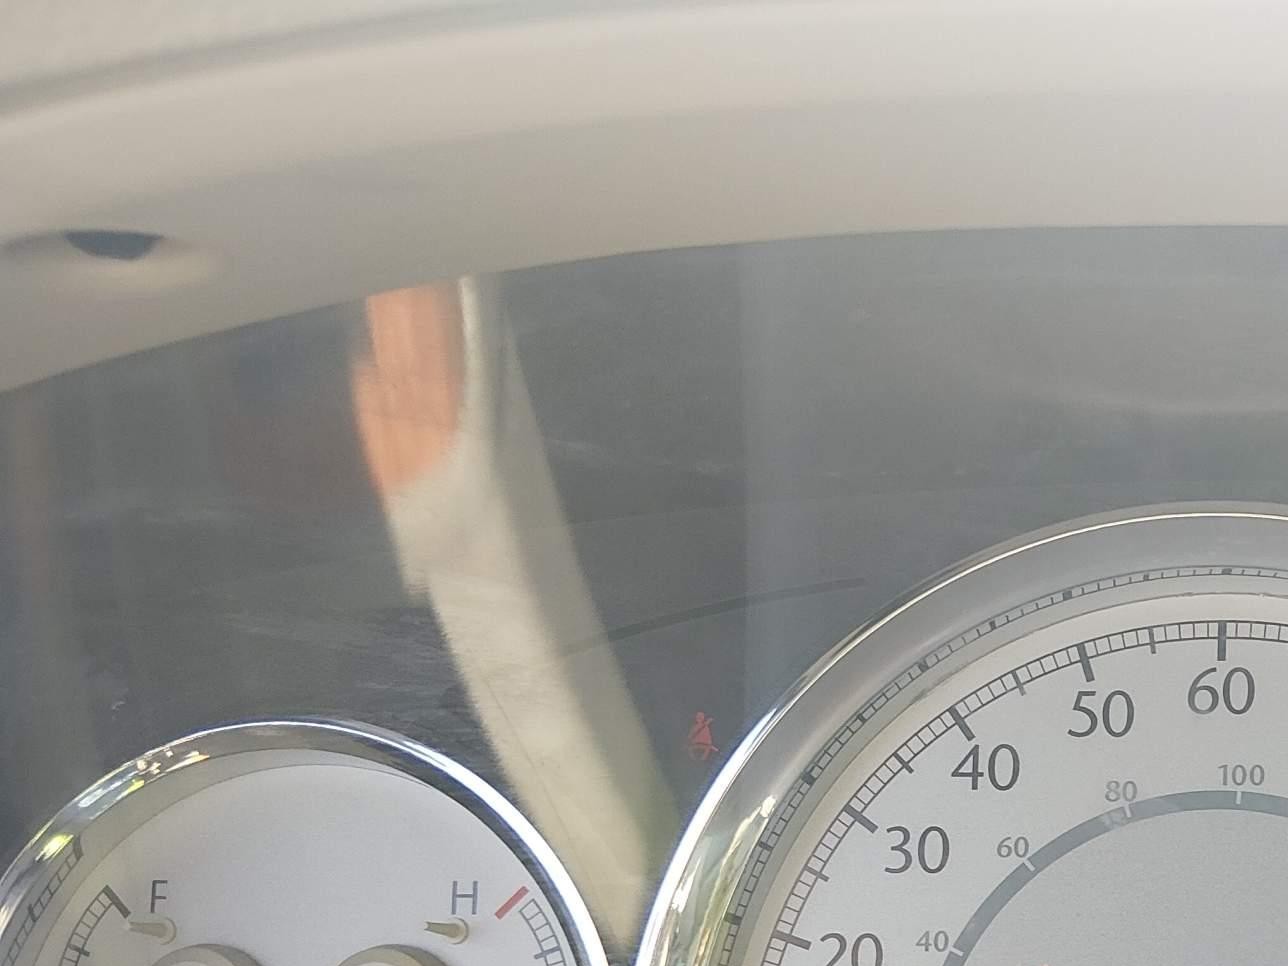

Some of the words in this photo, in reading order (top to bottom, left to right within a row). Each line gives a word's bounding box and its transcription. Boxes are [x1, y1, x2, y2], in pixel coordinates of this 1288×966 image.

[1187, 667, 1255, 715] 60
[1067, 690, 1134, 737] 50
[951, 744, 1020, 791] 40
[1218, 764, 1265, 787] 100
[1105, 780, 1137, 803] 80
[884, 826, 950, 873] 30
[996, 836, 1030, 859] 60
[150, 880, 168, 913] F
[451, 880, 478, 915] H
[916, 930, 949, 953] 40
